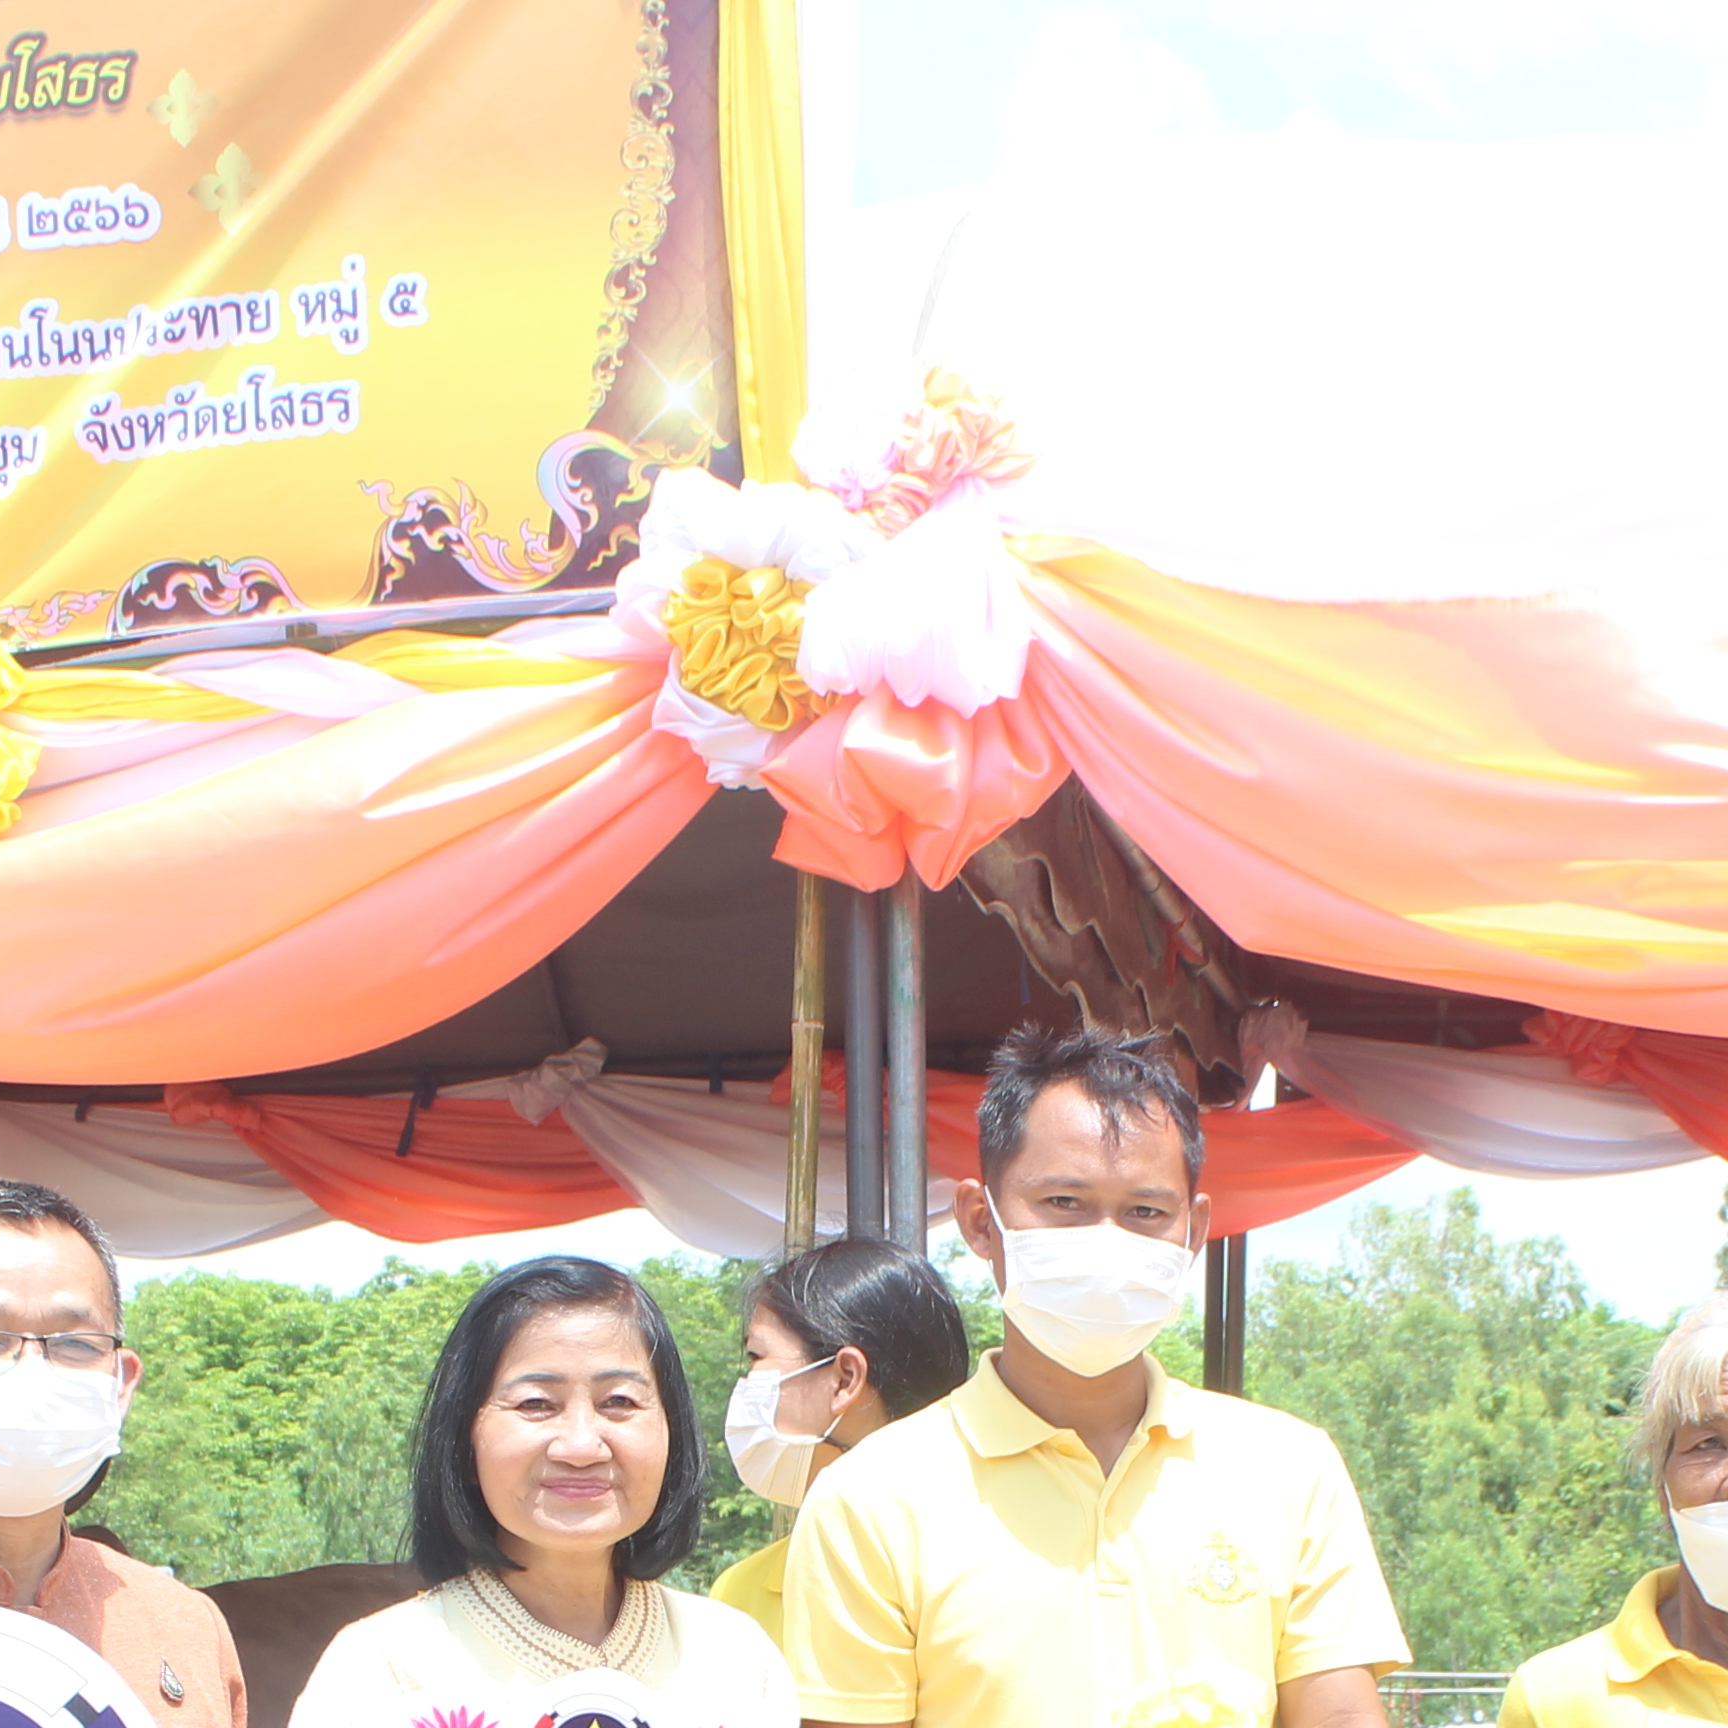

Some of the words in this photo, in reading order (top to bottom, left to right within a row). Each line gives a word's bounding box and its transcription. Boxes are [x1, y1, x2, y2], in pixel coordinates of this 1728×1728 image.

[26, 196, 152, 238] ๒๕๖๖
[297, 260, 359, 345] หมู่
[388, 280, 419, 317] ๕
[80, 373, 351, 455] จังหวัดยโสธร
